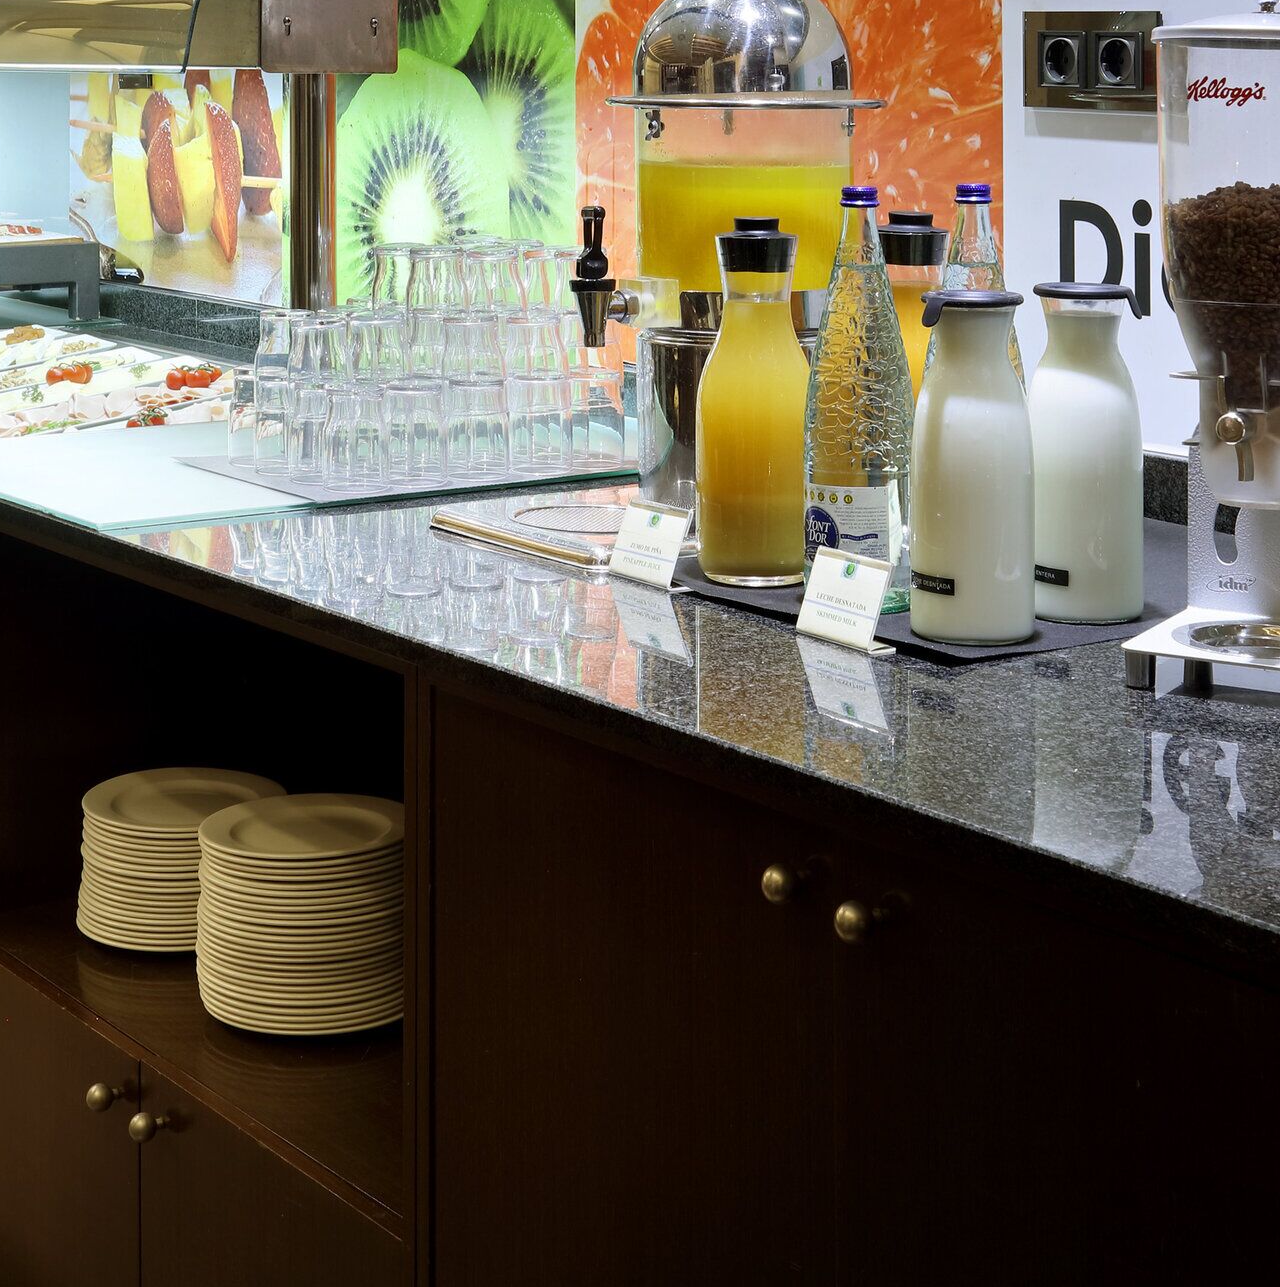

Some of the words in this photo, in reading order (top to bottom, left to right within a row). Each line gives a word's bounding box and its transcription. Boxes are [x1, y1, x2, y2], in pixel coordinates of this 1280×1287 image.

[1186, 76, 1266, 107] Kellogg's
[1035, 569, 1056, 579] ENTERA
[1218, 575, 1249, 592] idm
[816, 592, 834, 603] LECHE
[834, 597, 867, 612] DESNATADA
[816, 610, 842, 623] SKIMMED
[842, 618, 857, 627] MILK
